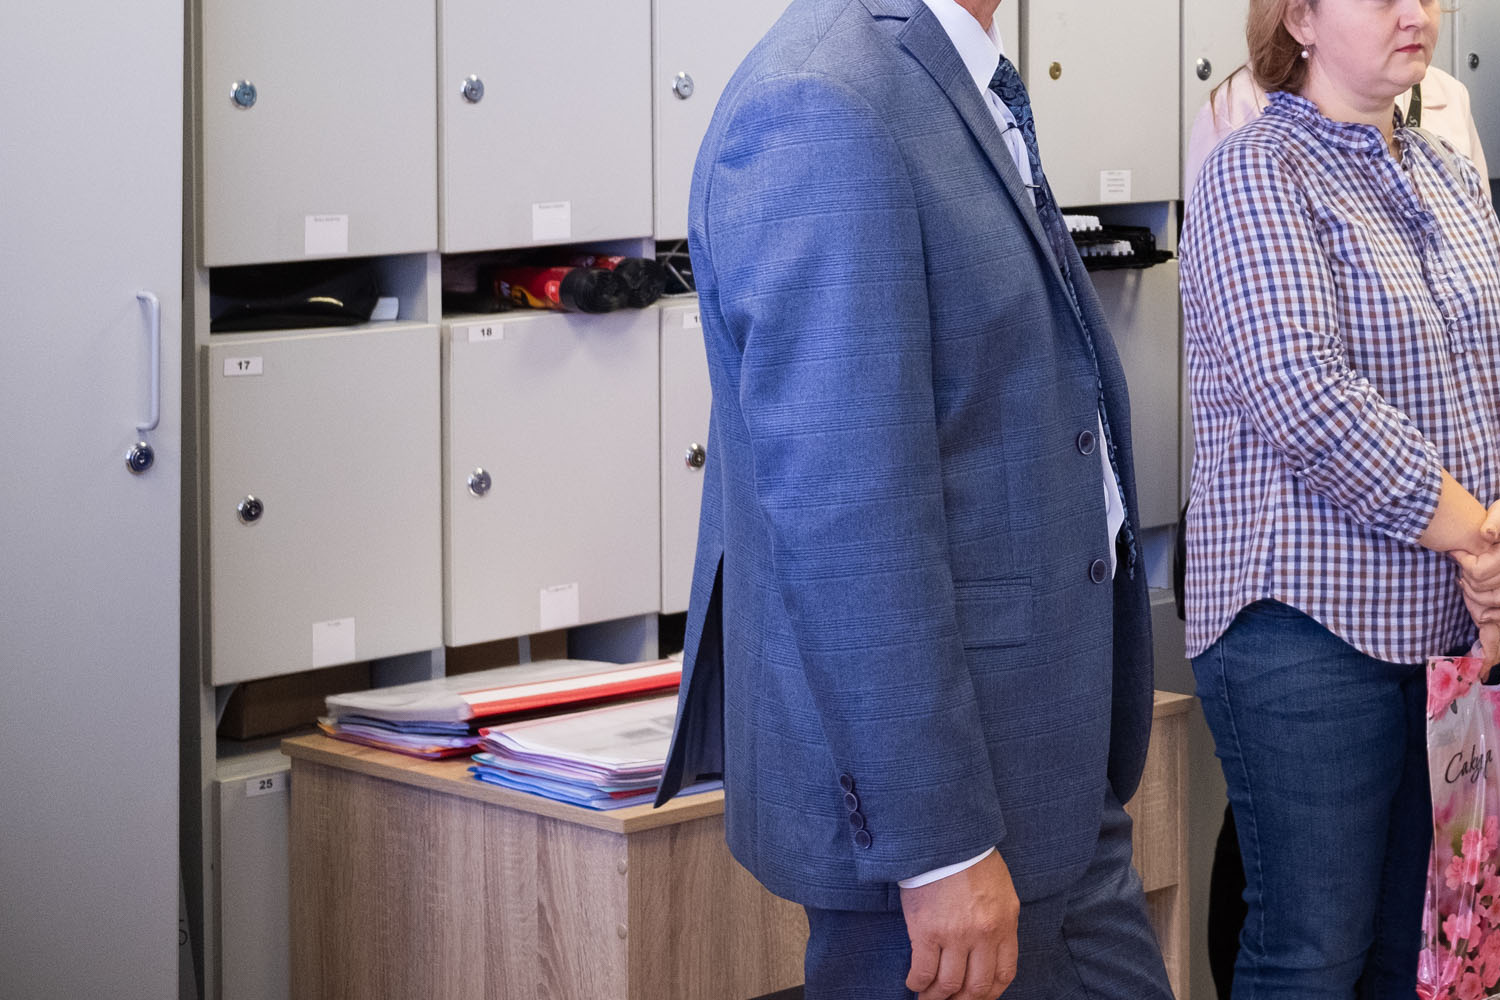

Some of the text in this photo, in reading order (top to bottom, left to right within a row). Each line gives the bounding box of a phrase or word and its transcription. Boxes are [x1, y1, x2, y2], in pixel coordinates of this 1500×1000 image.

[481, 327, 492, 337] 18
[238, 360, 250, 371] 17
[258, 778, 273, 791] 25
